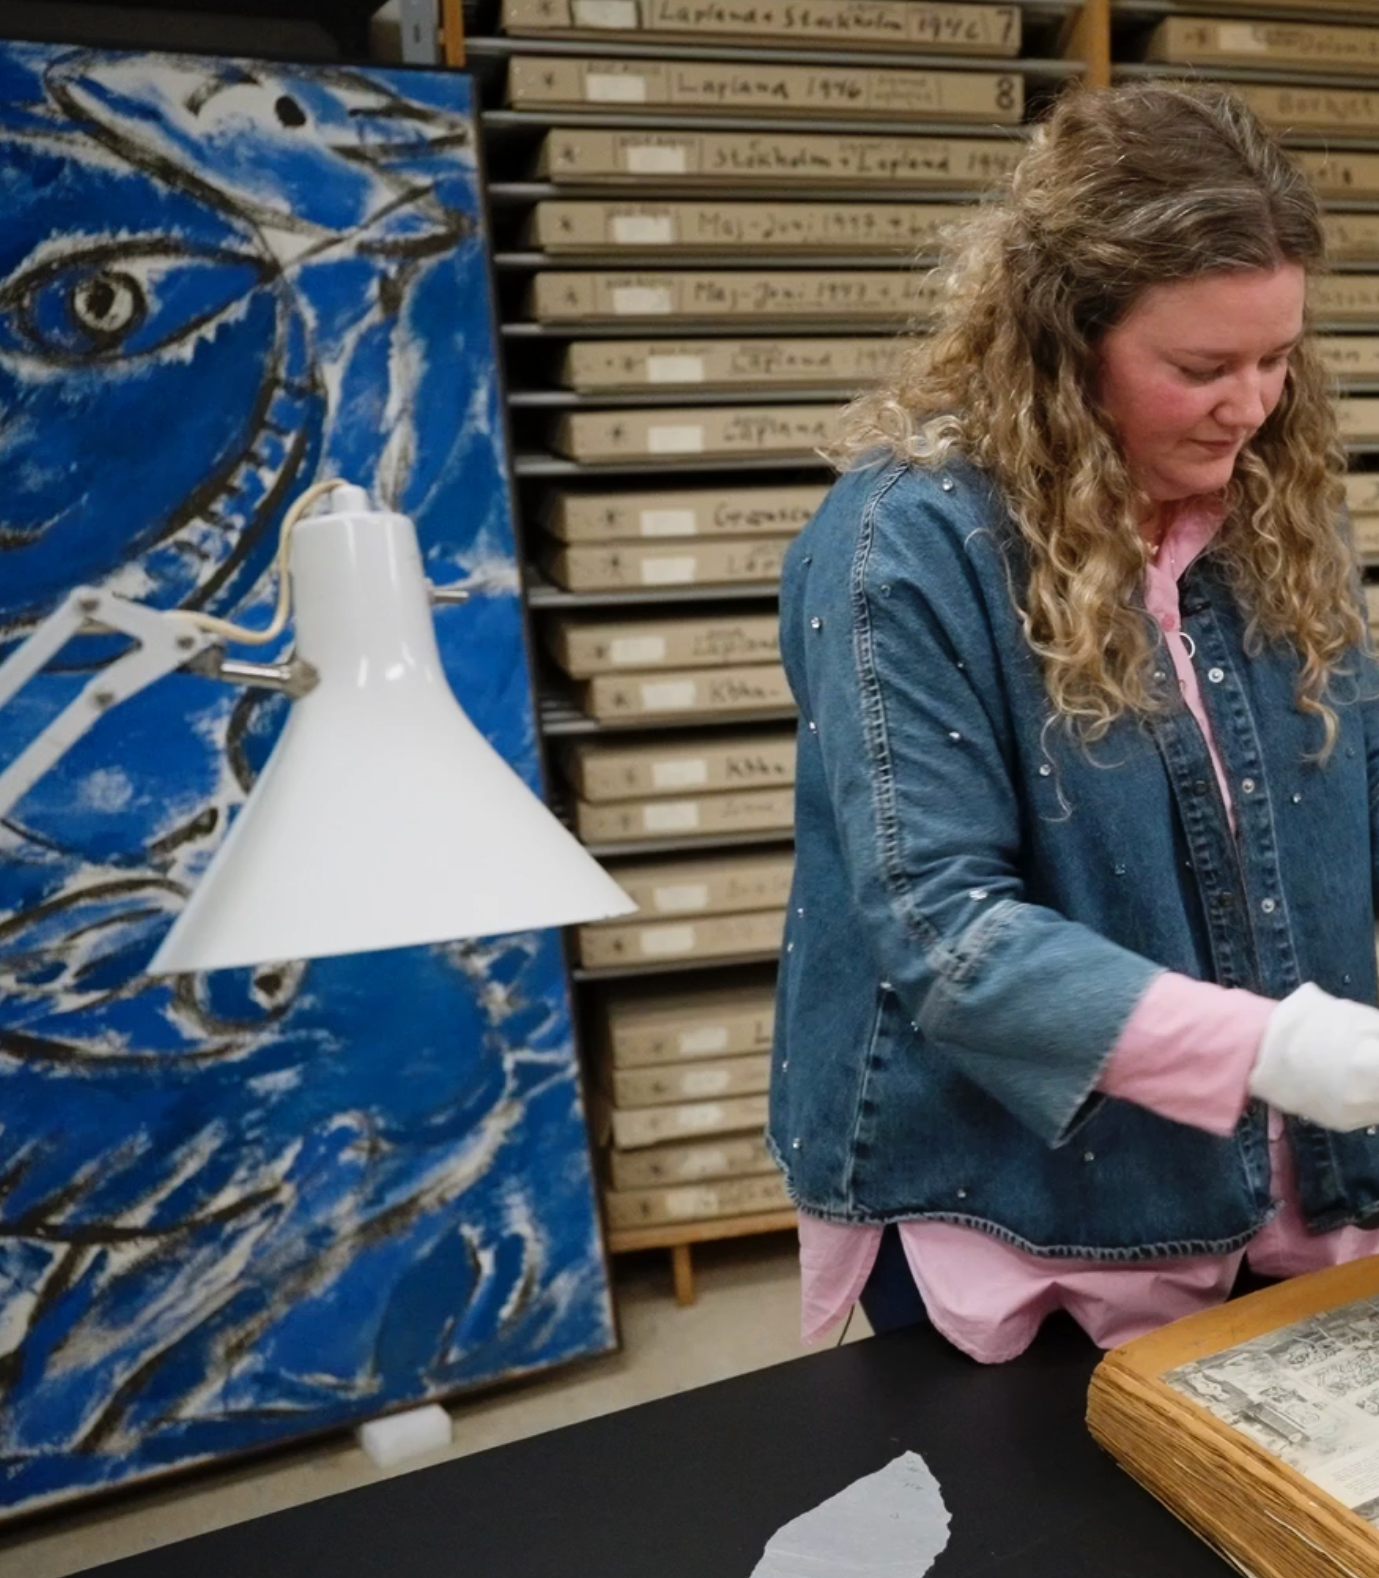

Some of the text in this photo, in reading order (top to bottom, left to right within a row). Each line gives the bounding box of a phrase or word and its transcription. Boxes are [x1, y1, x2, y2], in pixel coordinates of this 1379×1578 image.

[658, 1, 757, 24] Lapland
[996, 8, 1014, 42] 7
[676, 72, 790, 99] Lapland
[995, 76, 1015, 110] 8
